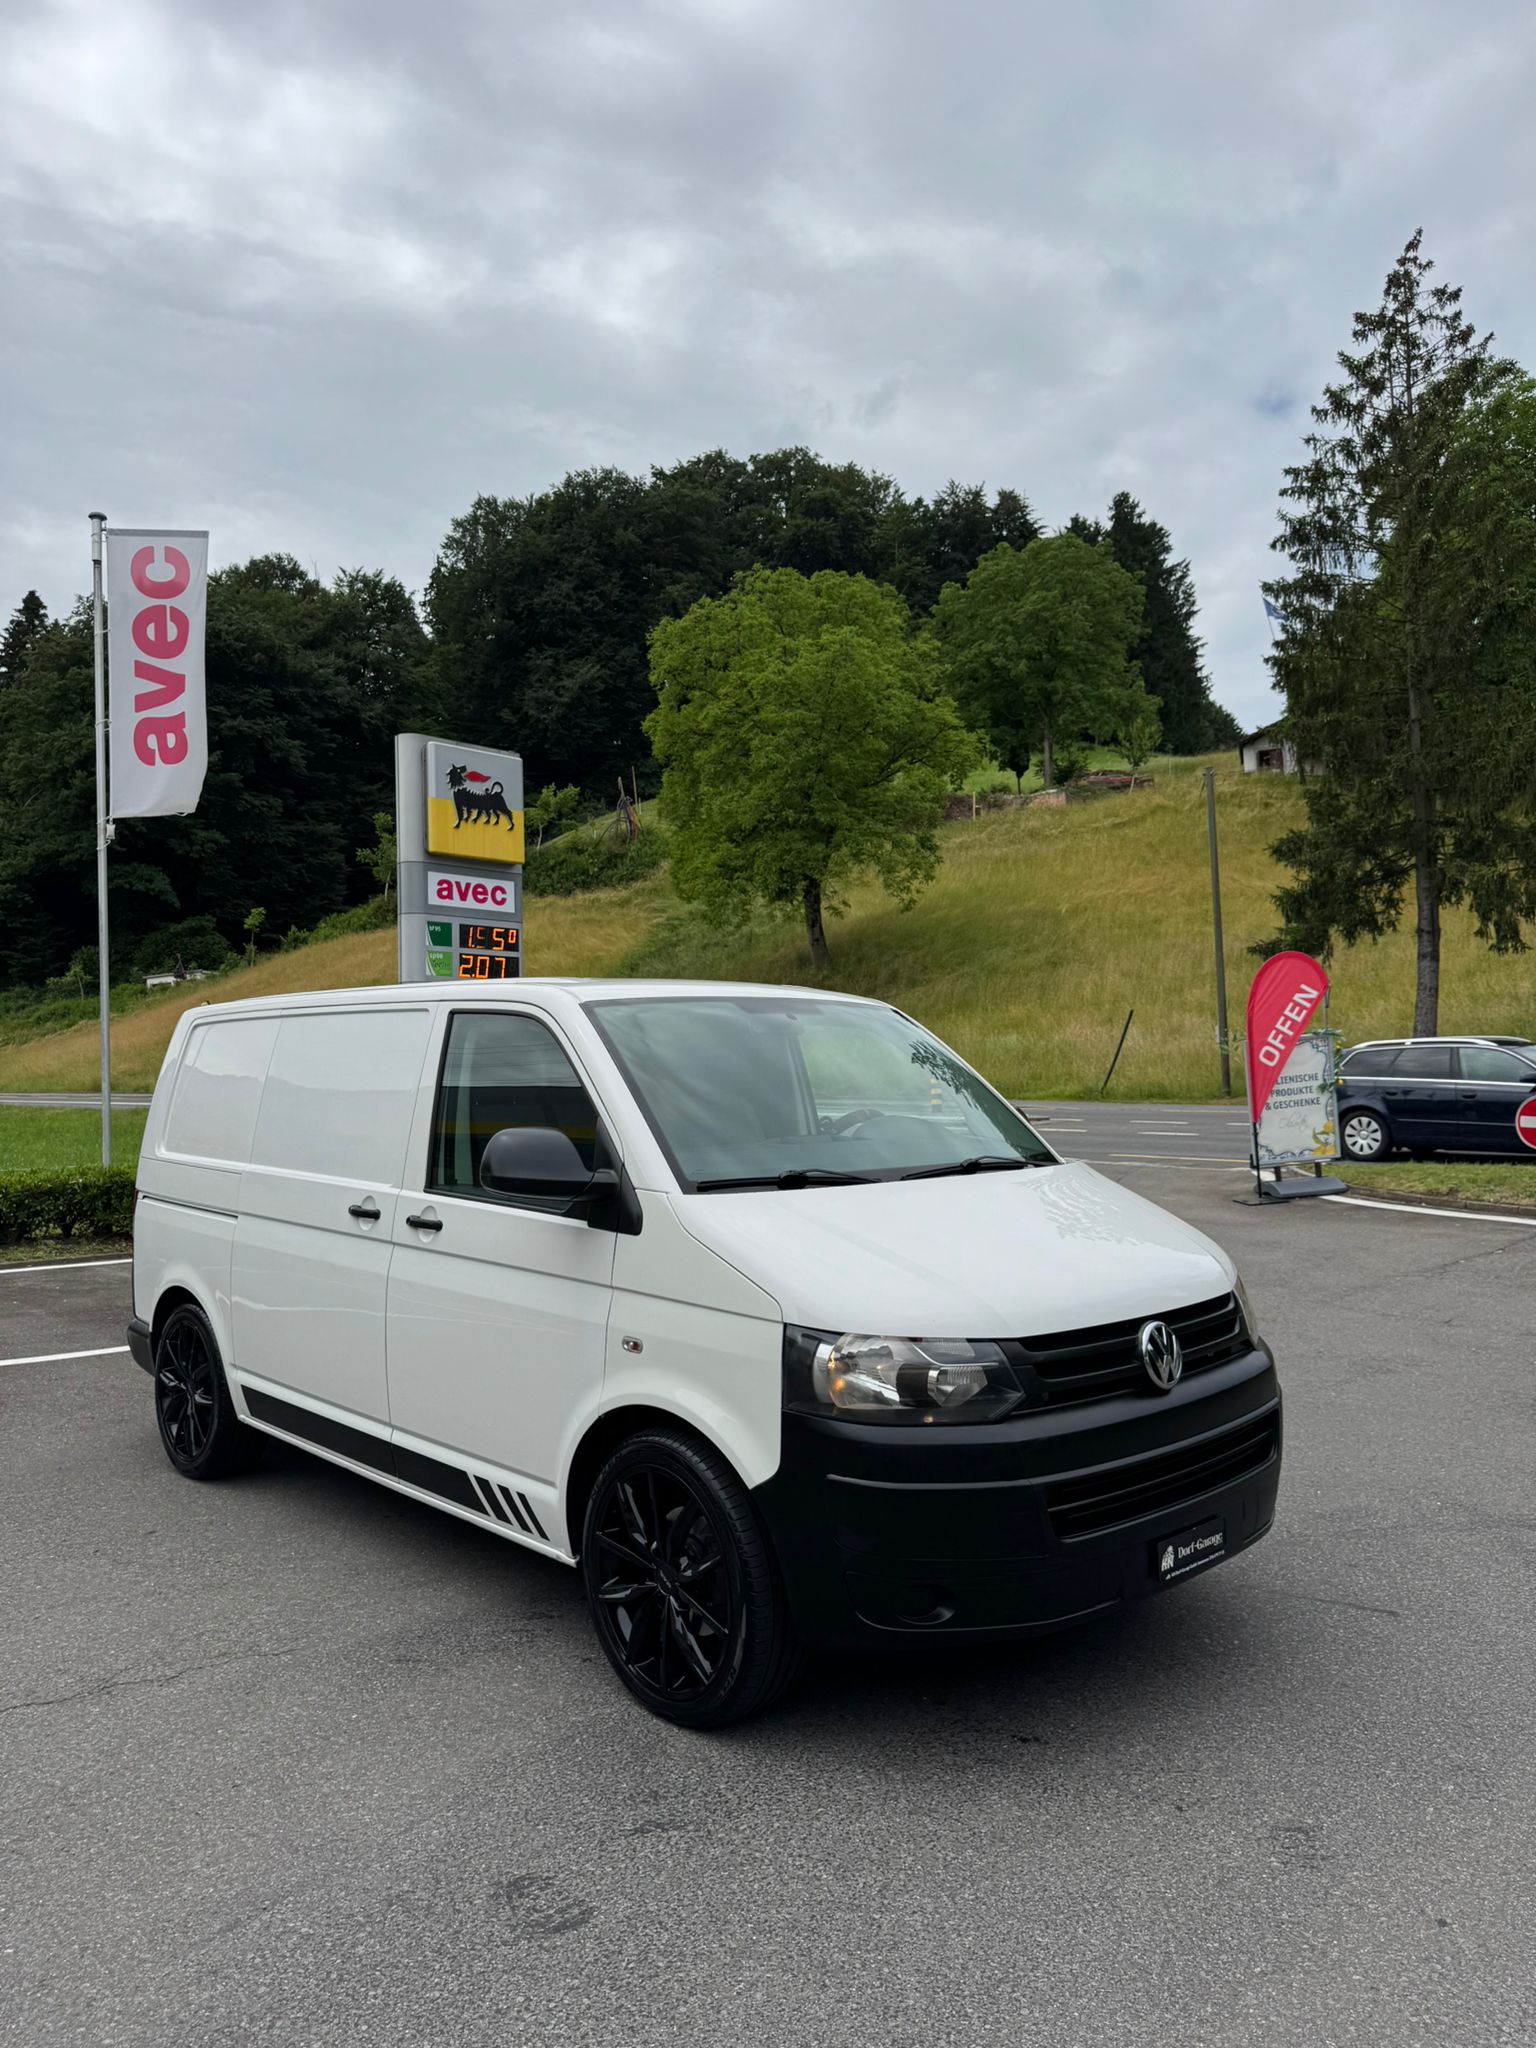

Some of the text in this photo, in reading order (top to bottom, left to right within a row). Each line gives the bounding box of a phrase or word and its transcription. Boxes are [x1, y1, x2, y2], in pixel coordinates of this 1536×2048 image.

[130, 545, 191, 767] avec
[436, 878, 508, 906] avec
[1259, 983, 1319, 1067] OFFEN
[1270, 1085, 1315, 1097] PRODUKTE
[1276, 1072, 1320, 1085] LIENISCHE
[1264, 1096, 1321, 1111] & GESCHENKE
[1178, 1532, 1223, 1559] Dorf-Garage
